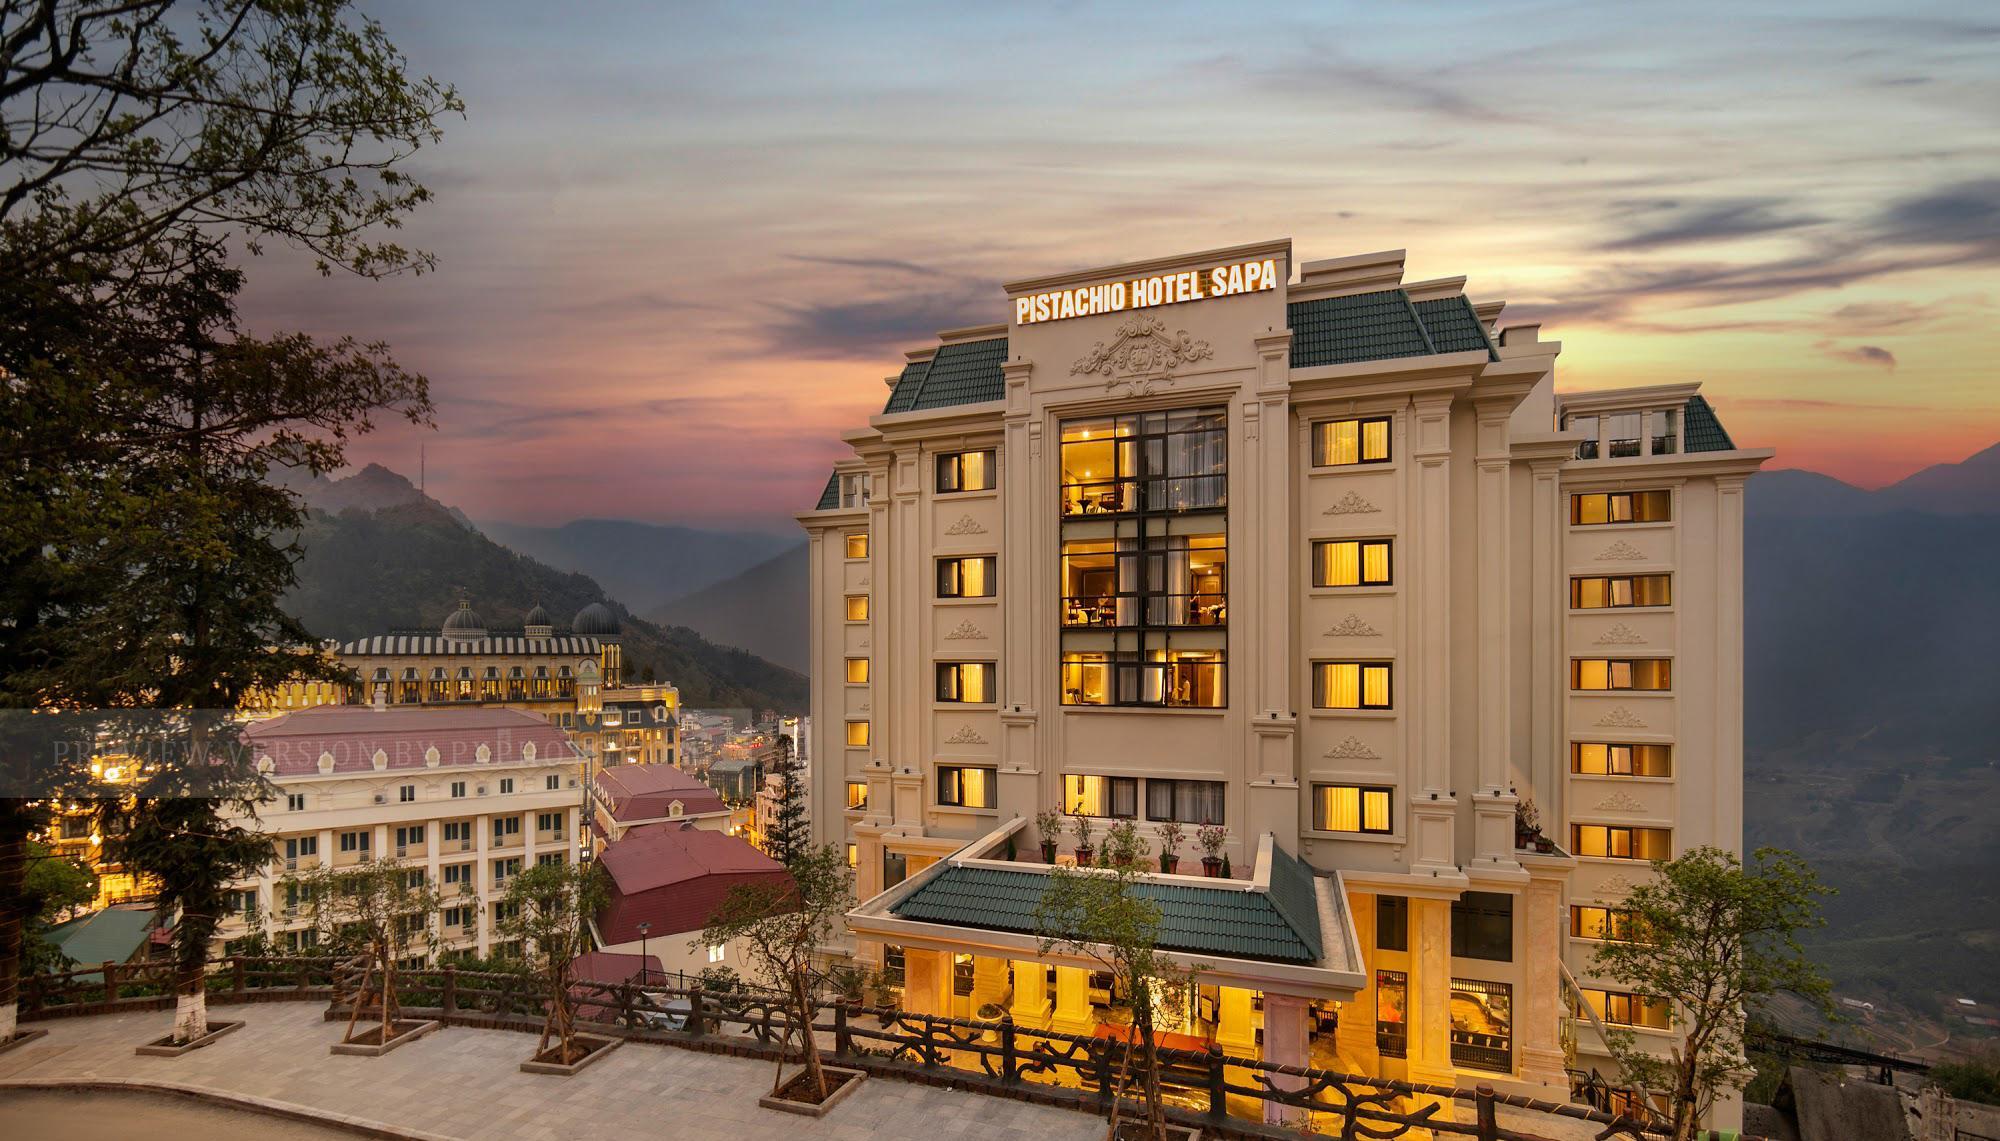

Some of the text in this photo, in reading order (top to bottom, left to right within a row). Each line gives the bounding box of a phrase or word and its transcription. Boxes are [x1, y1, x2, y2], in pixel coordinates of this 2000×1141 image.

[1016, 258, 1278, 326] PISTACHIO HOTEL SAPA
